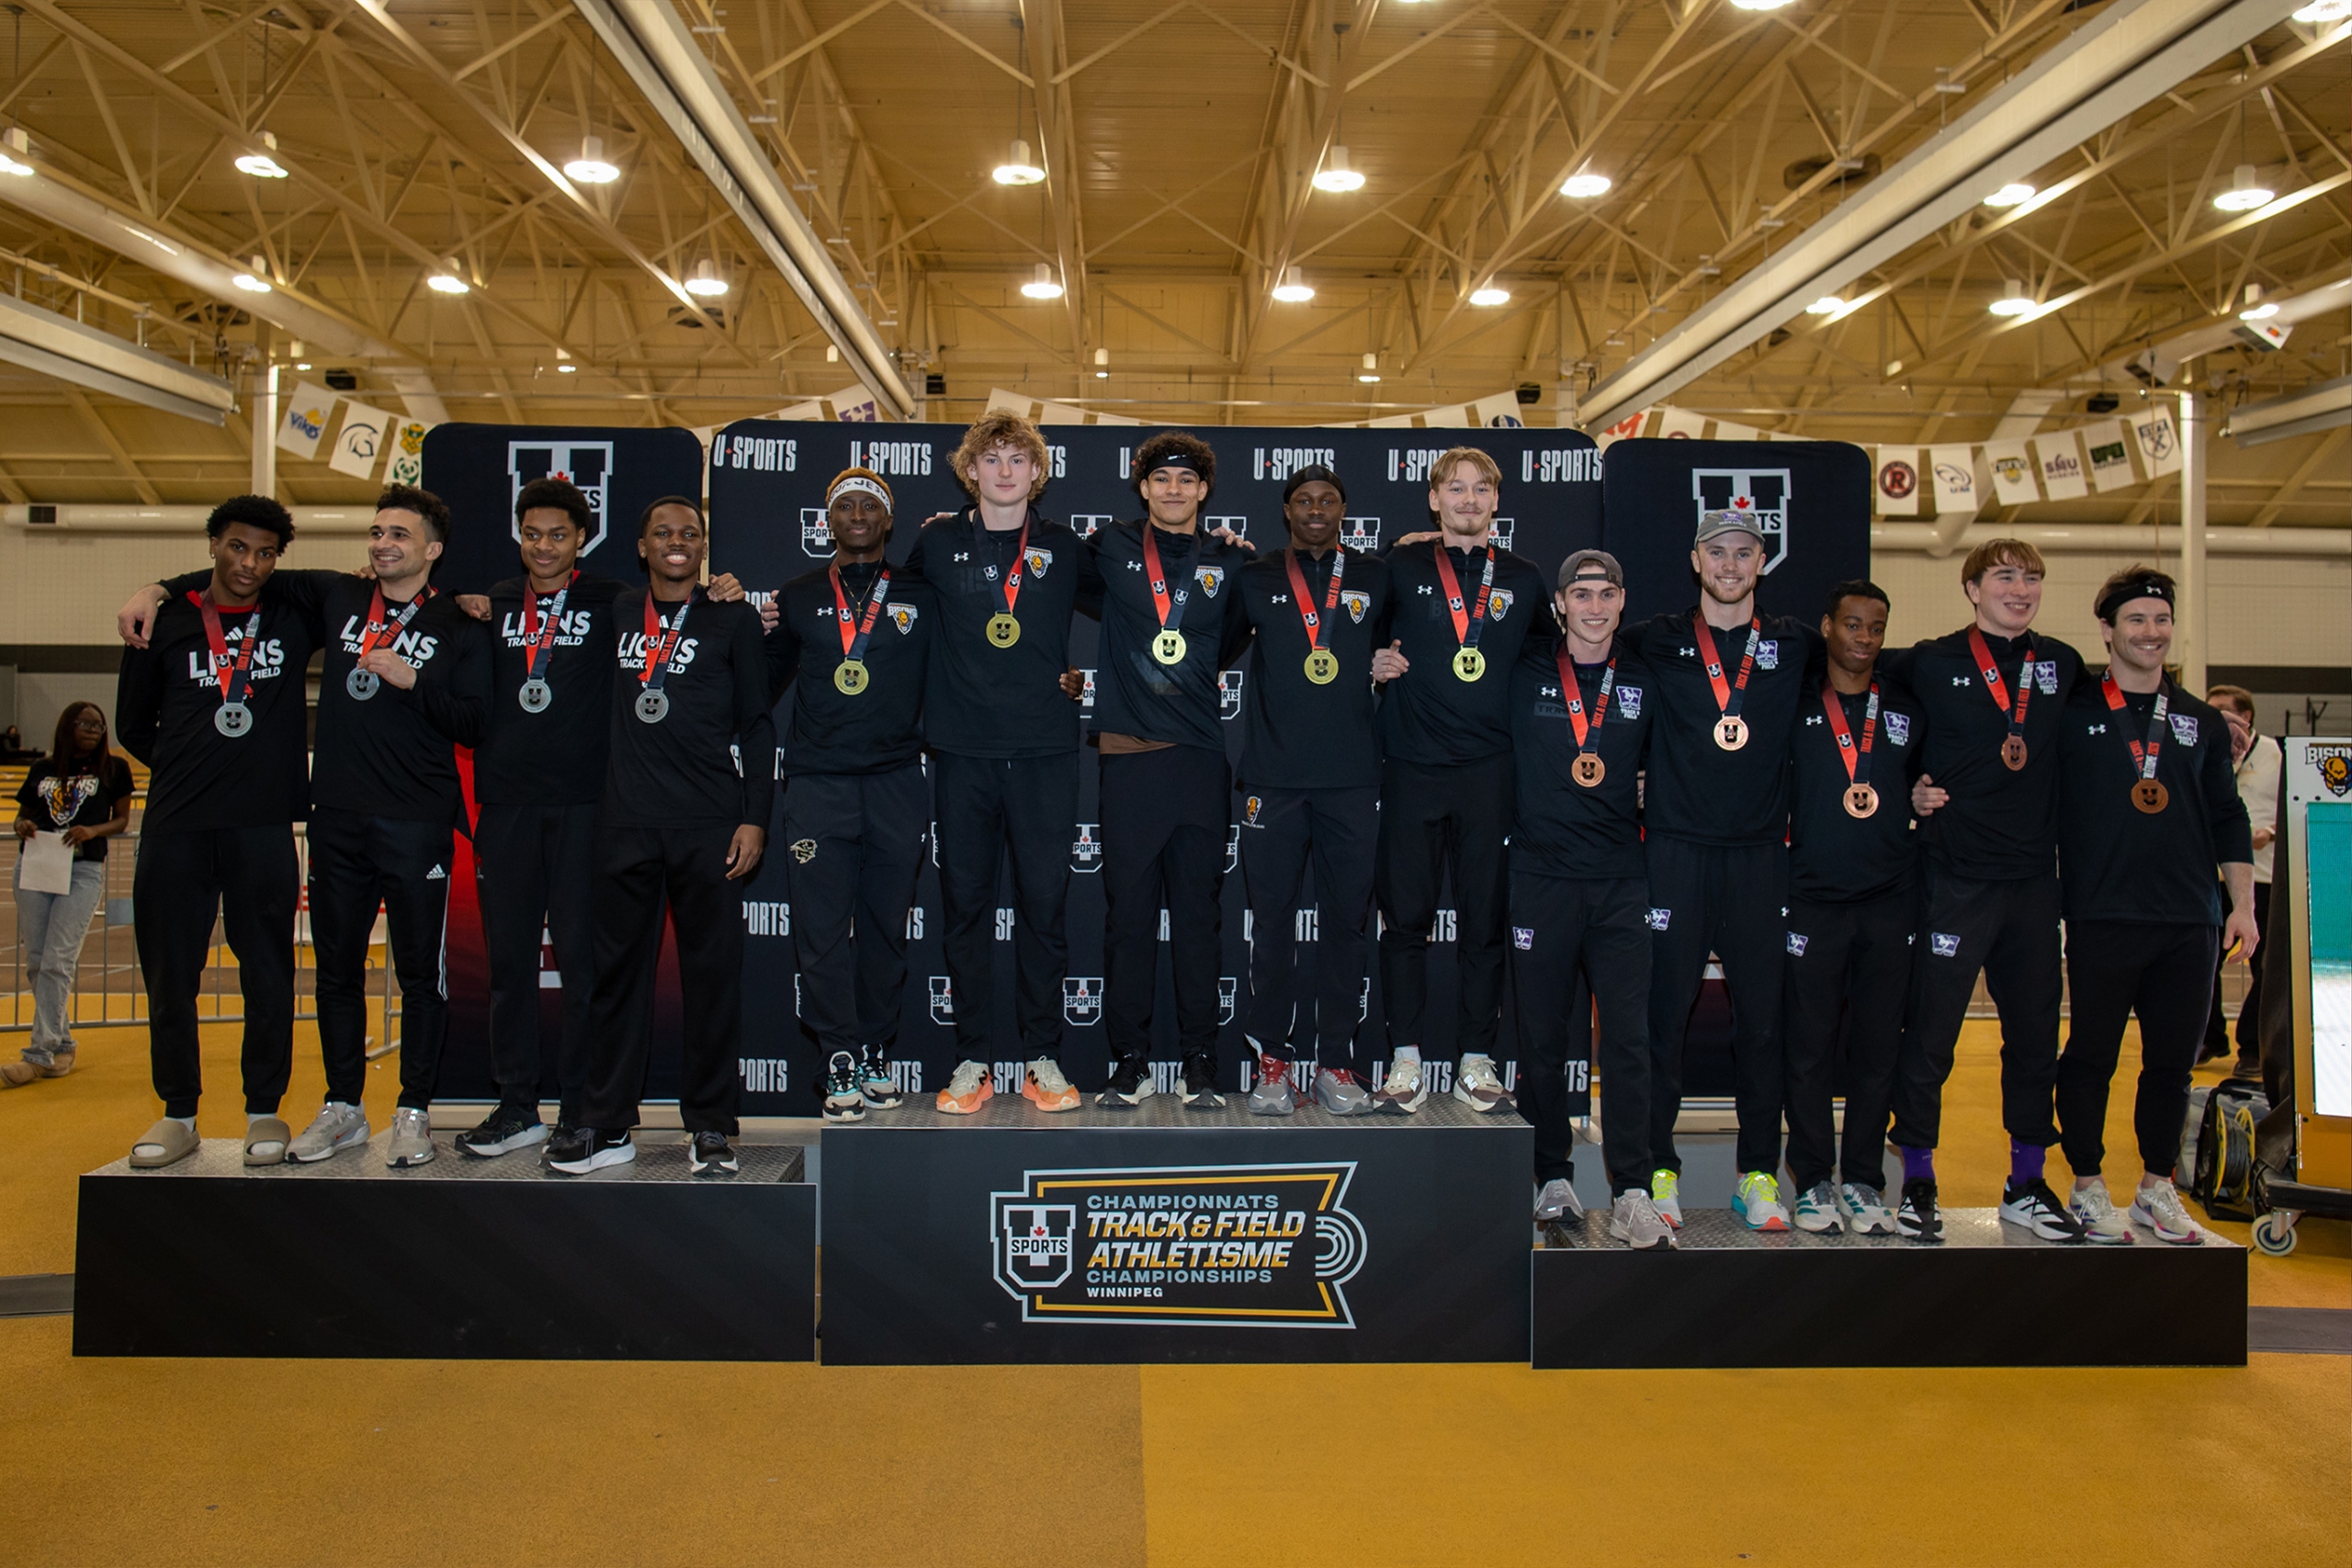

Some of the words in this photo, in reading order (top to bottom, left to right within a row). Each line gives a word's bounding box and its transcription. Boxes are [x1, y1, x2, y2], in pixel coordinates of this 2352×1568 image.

[731, 435, 797, 472] SPORTS
[868, 441, 932, 475] SPORTS
[1540, 447, 1603, 482] SPORTS
[804, 528, 835, 537] SPORT
[1342, 536, 1376, 547] SPORTS
[1488, 538, 1510, 547] ORTS
[1195, 568, 1225, 581] BISONS
[1341, 592, 1370, 606] BISONS
[888, 605, 918, 618] BISONS
[340, 614, 439, 660] LINS
[507, 637, 526, 648] TRA
[553, 636, 583, 646] FIELD
[619, 659, 645, 669] TRACK
[198, 675, 221, 687] TRA
[251, 667, 280, 680] FIELD
[1066, 997, 1100, 1007] SPORTS
[1087, 1195, 1279, 1210] CHAMPIONNATS
[1012, 1238, 1068, 1254] SPORTS
[1086, 1236, 1294, 1269] ATHLÉTISME
[1087, 1270, 1272, 1284] CHAMPIONSHIPS
[1087, 1287, 1163, 1298] WINNIPEG
